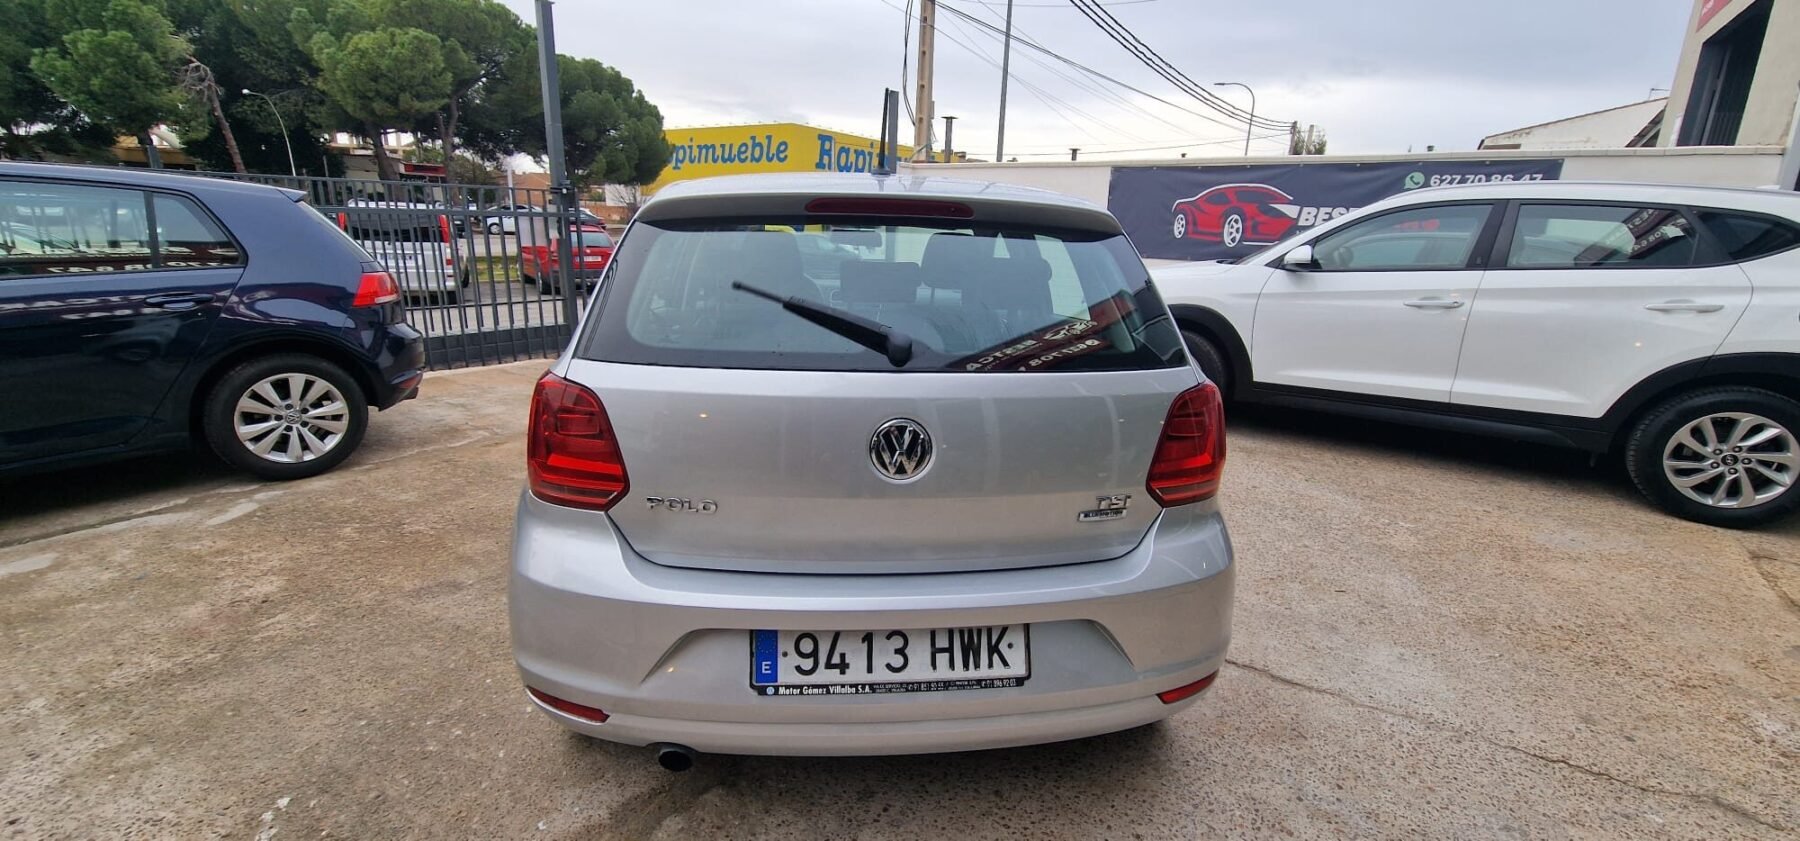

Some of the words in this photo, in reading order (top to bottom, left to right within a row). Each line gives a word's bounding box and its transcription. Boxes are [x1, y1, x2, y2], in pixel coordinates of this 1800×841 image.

[668, 135, 788, 170] pimueble
[815, 134, 886, 172] Rapi
[646, 496, 718, 513] POLO
[794, 630, 909, 676] 9413
[930, 626, 1011, 673] HWK
[761, 661, 771, 673] E
[778, 687, 800, 695] Motor
[803, 686, 827, 695] Gómez
[829, 685, 856, 694] Villalba
